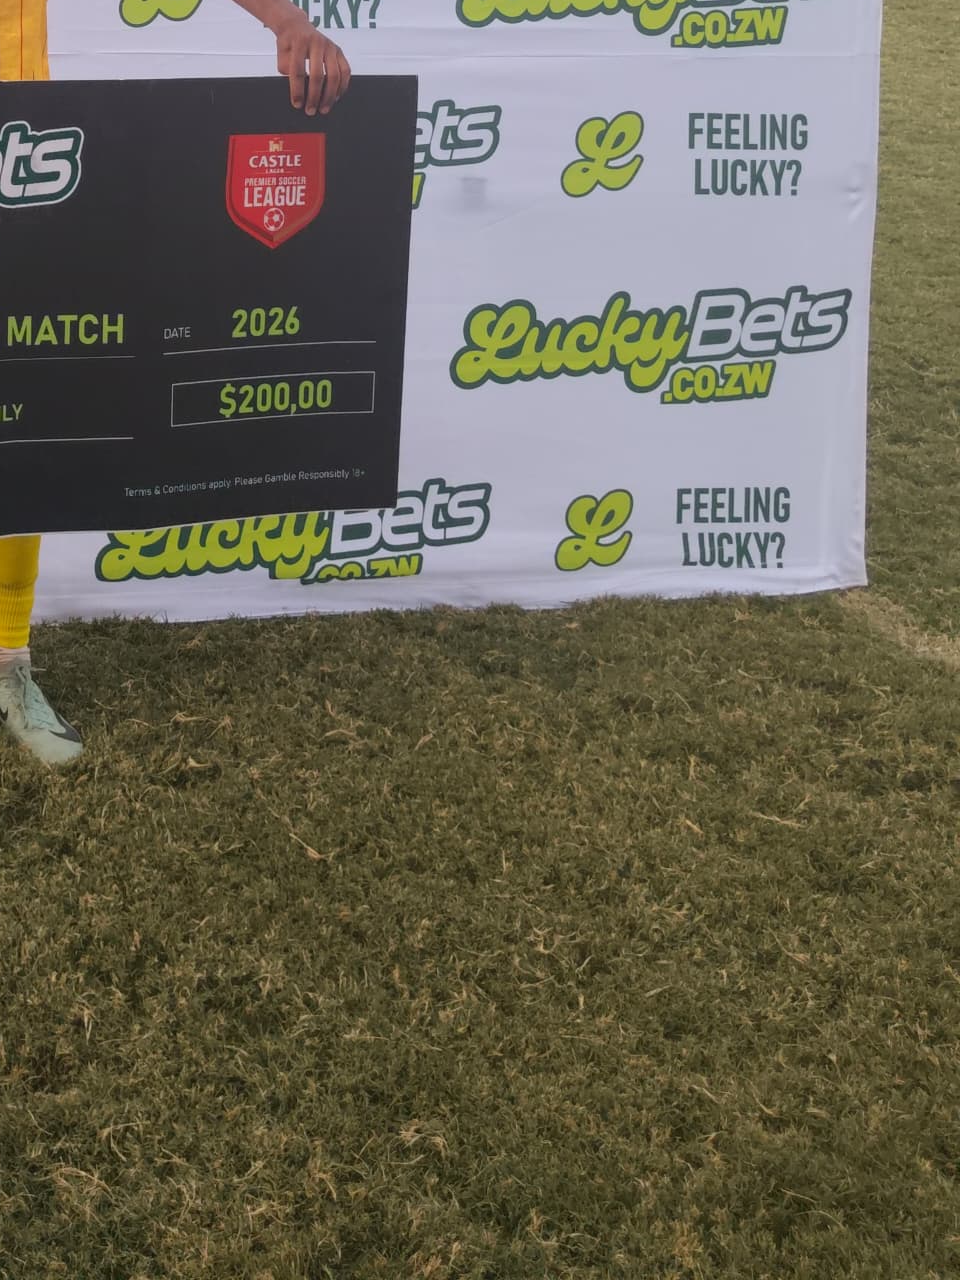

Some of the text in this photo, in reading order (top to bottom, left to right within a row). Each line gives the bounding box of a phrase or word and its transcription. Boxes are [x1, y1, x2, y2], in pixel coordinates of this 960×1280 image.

[671, 5, 787, 48] .CO.ZW
[688, 112, 808, 151] FEELING
[248, 154, 302, 169] CASTLE
[694, 158, 803, 197] LUCKY?
[243, 185, 307, 208] LEAGUE
[244, 176, 307, 187] PREMIER SOCCER
[7, 313, 125, 347] MATCH
[163, 326, 191, 340] DATE
[231, 306, 301, 338] 2026
[450, 286, 851, 393] LuckyBets
[219, 379, 333, 419] $200,00
[661, 360, 776, 404] .CO.ZW
[124, 486, 152, 498] Terms
[153, 486, 161, 496] &
[162, 481, 207, 494] Conditions
[234, 475, 263, 487] Please
[264, 472, 297, 484] Gamble
[298, 469, 350, 481] Responsibly
[676, 487, 791, 524] FEELING
[681, 532, 785, 569] LUCKY?
